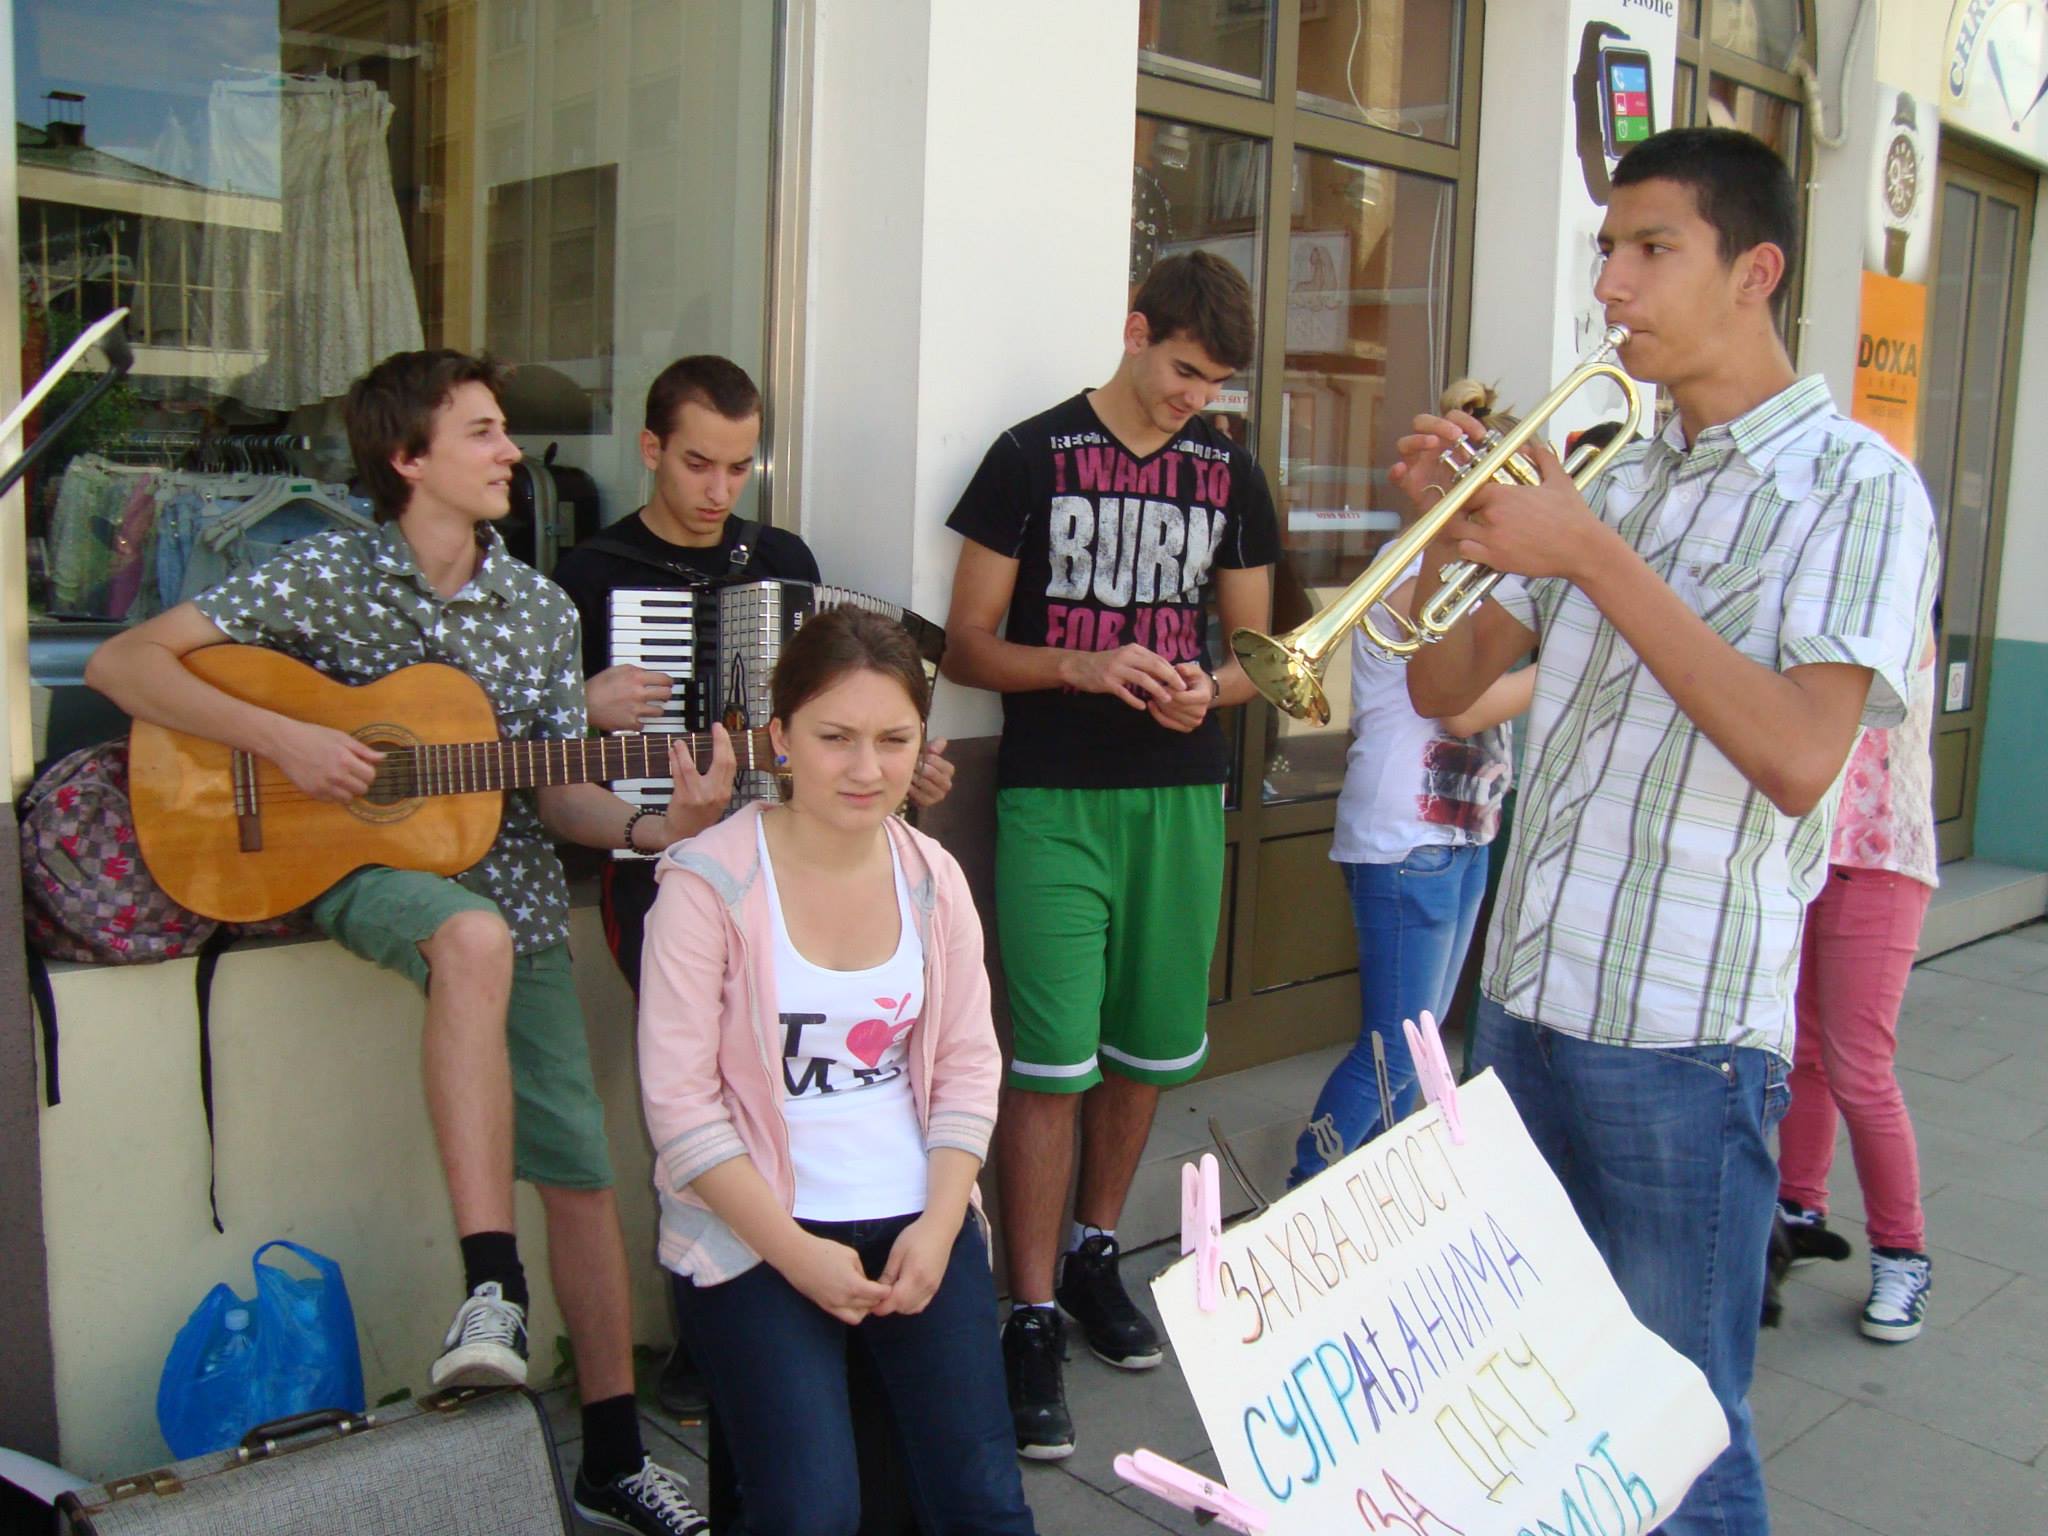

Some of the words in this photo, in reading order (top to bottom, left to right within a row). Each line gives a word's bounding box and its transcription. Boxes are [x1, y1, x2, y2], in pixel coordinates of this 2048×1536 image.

[1858, 333, 1917, 378] DOXA
[1054, 453, 1067, 493] I
[1075, 447, 1183, 498] WANT
[1191, 456, 1232, 508] TO
[1045, 495, 1227, 608] BURN
[1046, 604, 1126, 651] FOR
[1134, 606, 1202, 663] YOU
[1219, 1117, 1468, 1344] ЗАХВАЛНОСТ
[1243, 1211, 1543, 1503] СУГРАЂАНИМА
[1356, 1468, 1465, 1536] ЗА
[1434, 1331, 1578, 1505] ДАТУ
